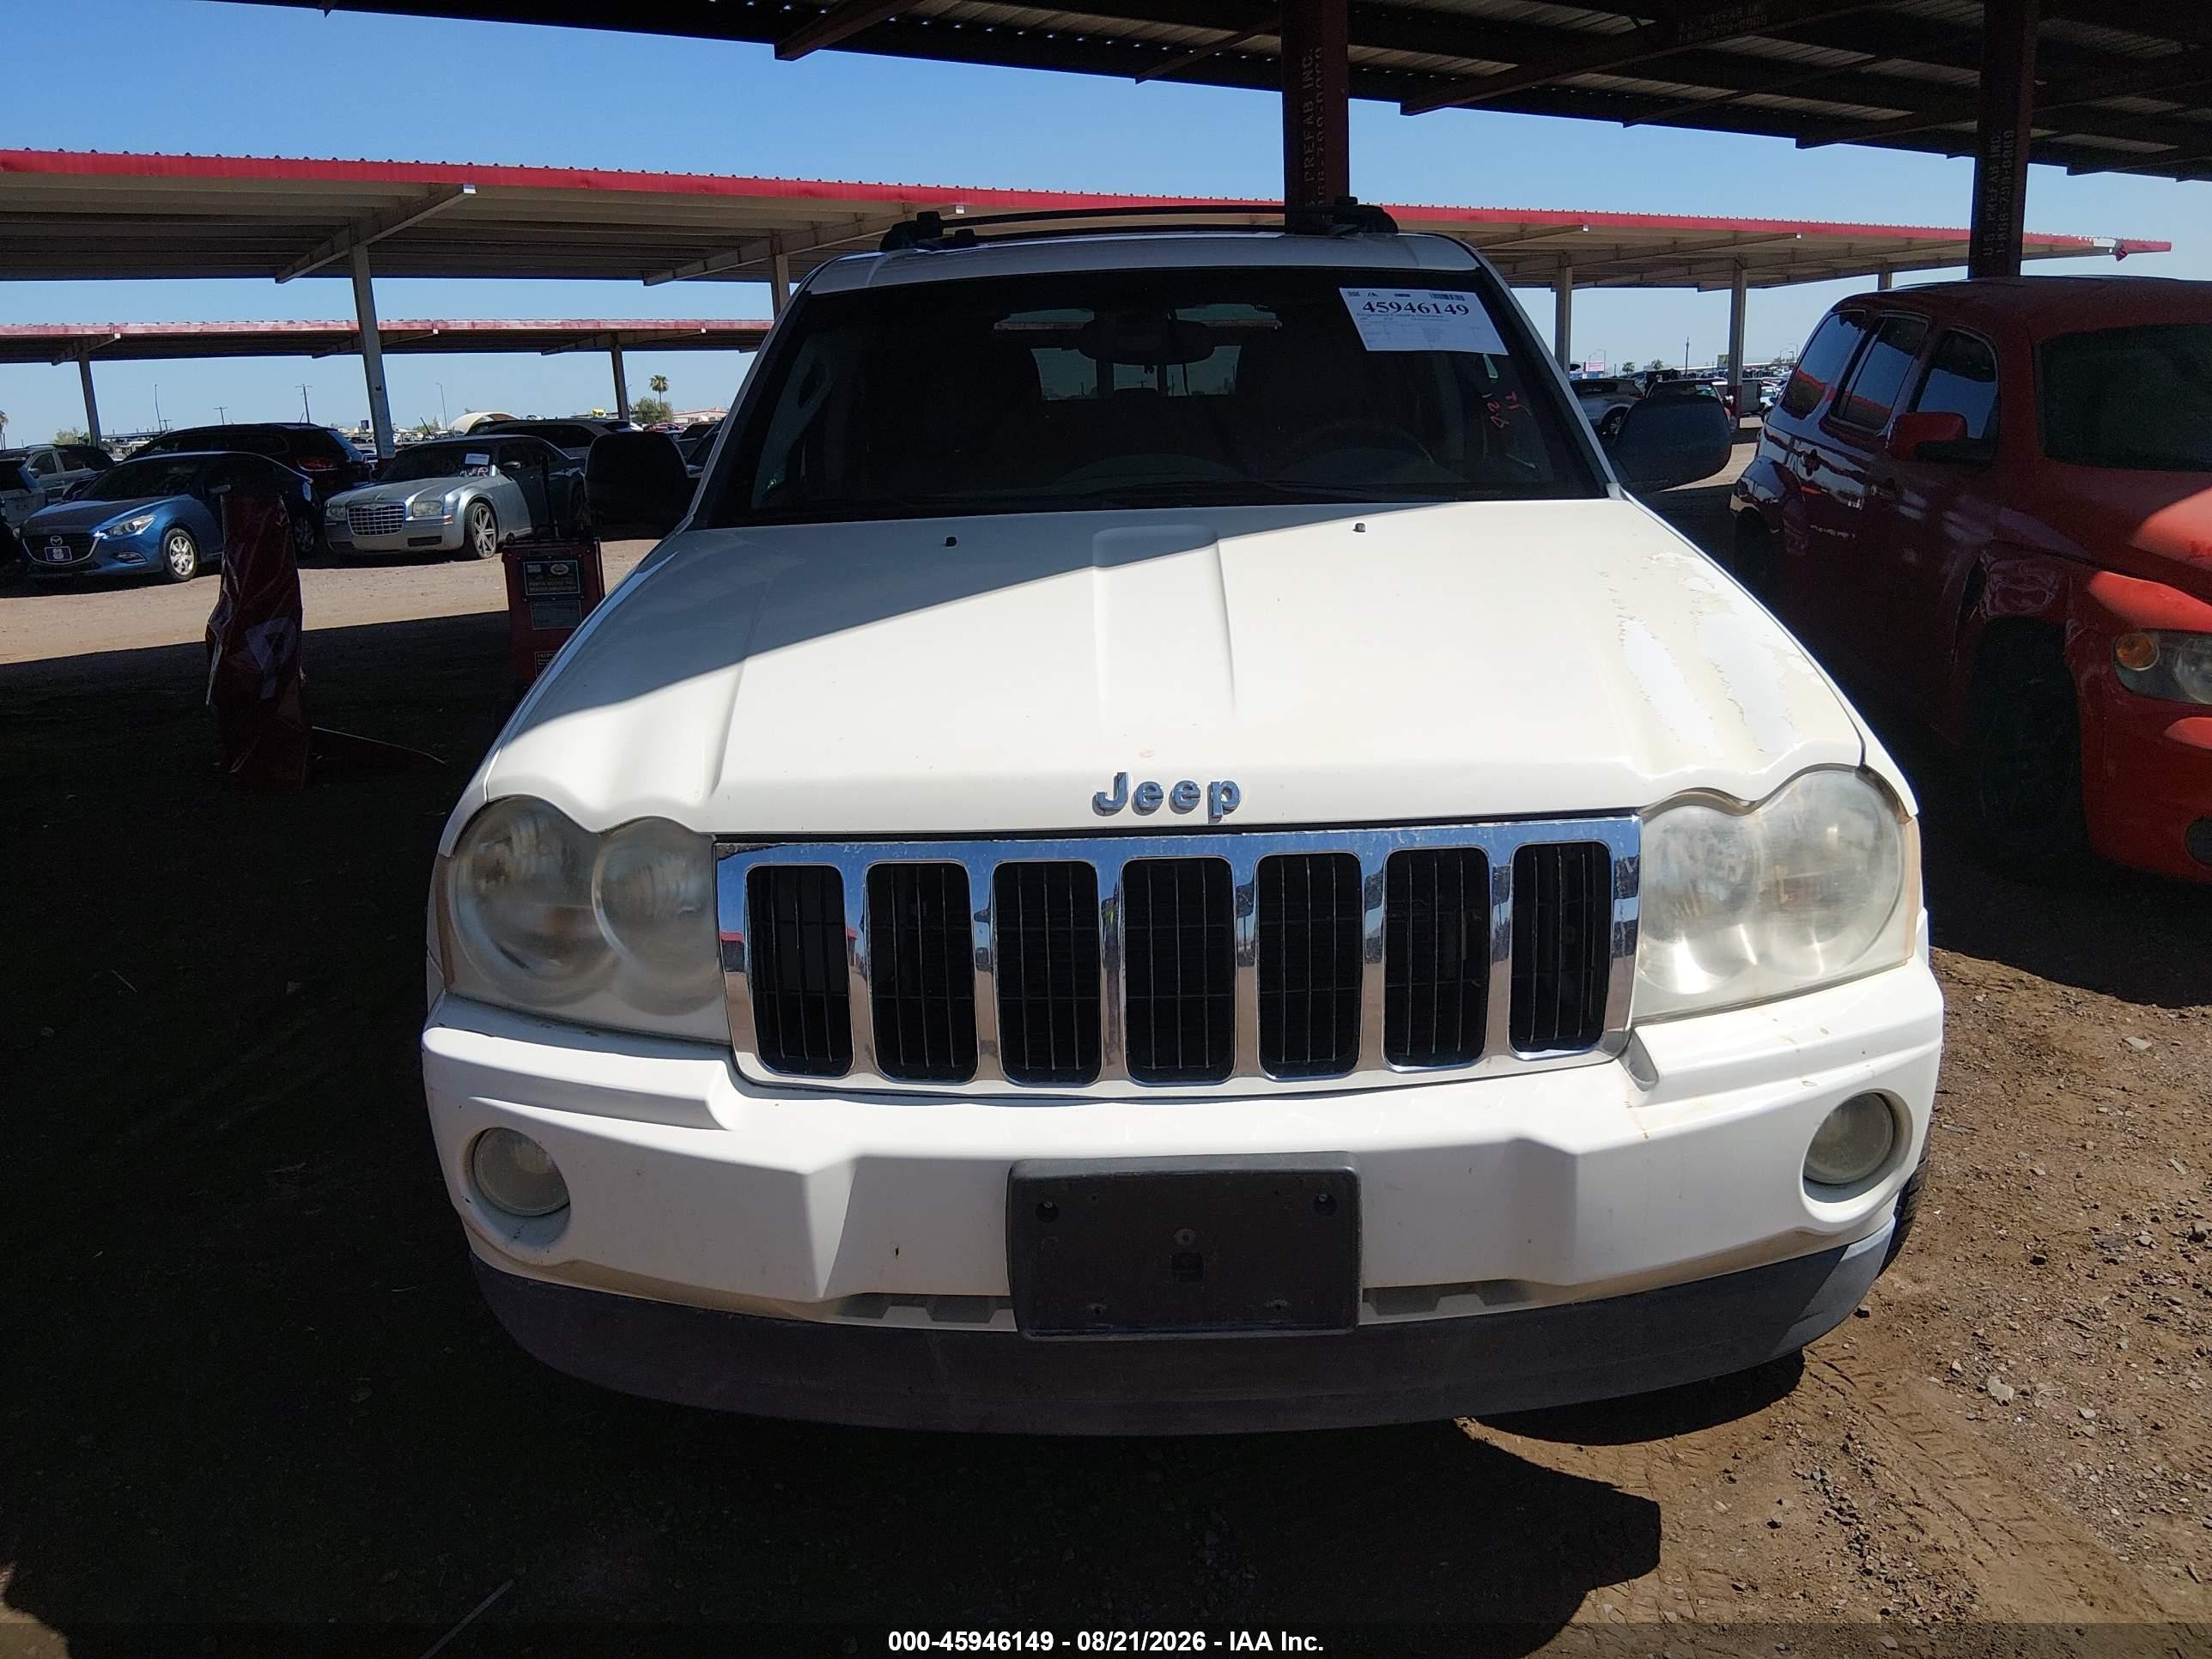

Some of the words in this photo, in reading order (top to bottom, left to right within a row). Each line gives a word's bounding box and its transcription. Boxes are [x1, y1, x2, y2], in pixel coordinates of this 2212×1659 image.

[1303, 101, 1315, 182] PREFAB
[1363, 301, 1469, 315] 45946149
[1094, 771, 1242, 820] Jeep
